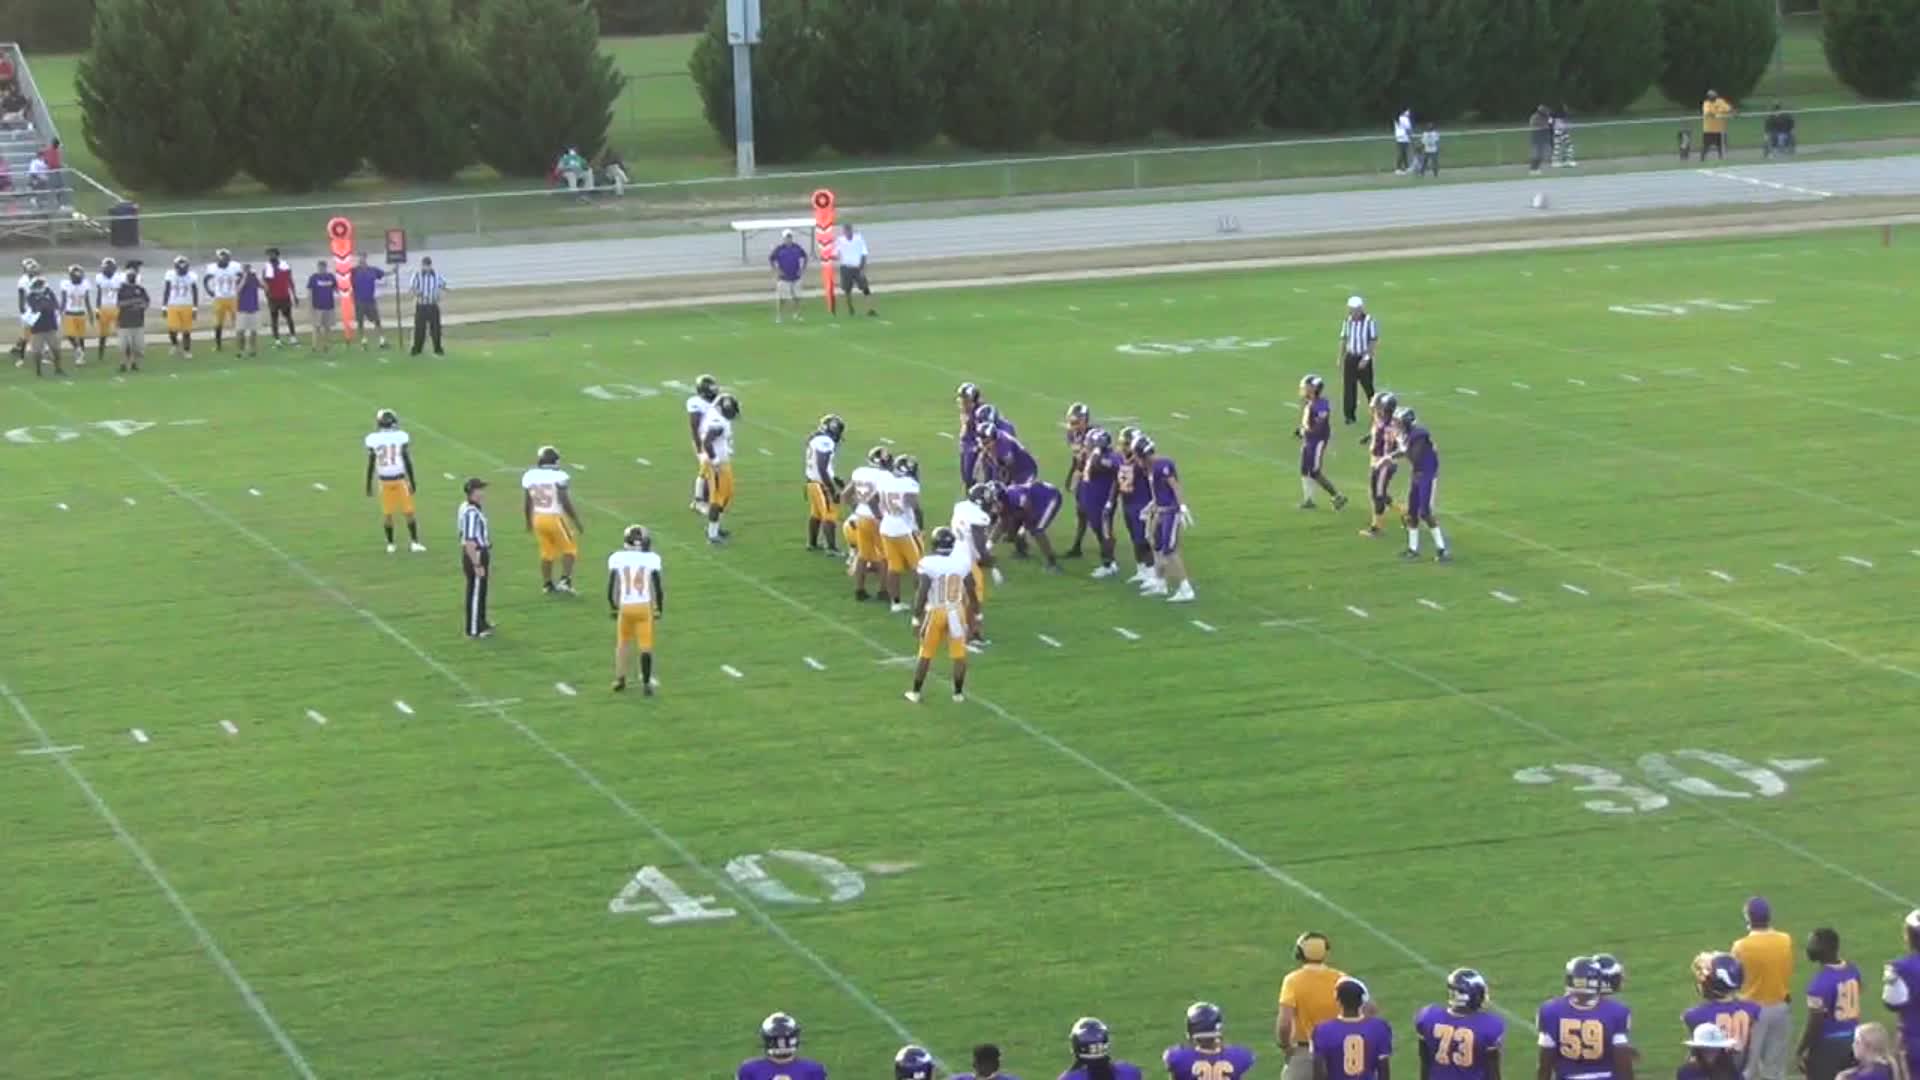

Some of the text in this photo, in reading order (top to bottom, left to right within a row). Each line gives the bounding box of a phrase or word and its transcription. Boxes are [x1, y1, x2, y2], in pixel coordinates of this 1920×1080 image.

[624, 565, 646, 596] 14
[1512, 749, 1787, 813] 30
[608, 849, 866, 924] 40
[1343, 1034, 1365, 1075] 8
[1433, 1023, 1474, 1067] 73
[1560, 1017, 1604, 1060] 59
